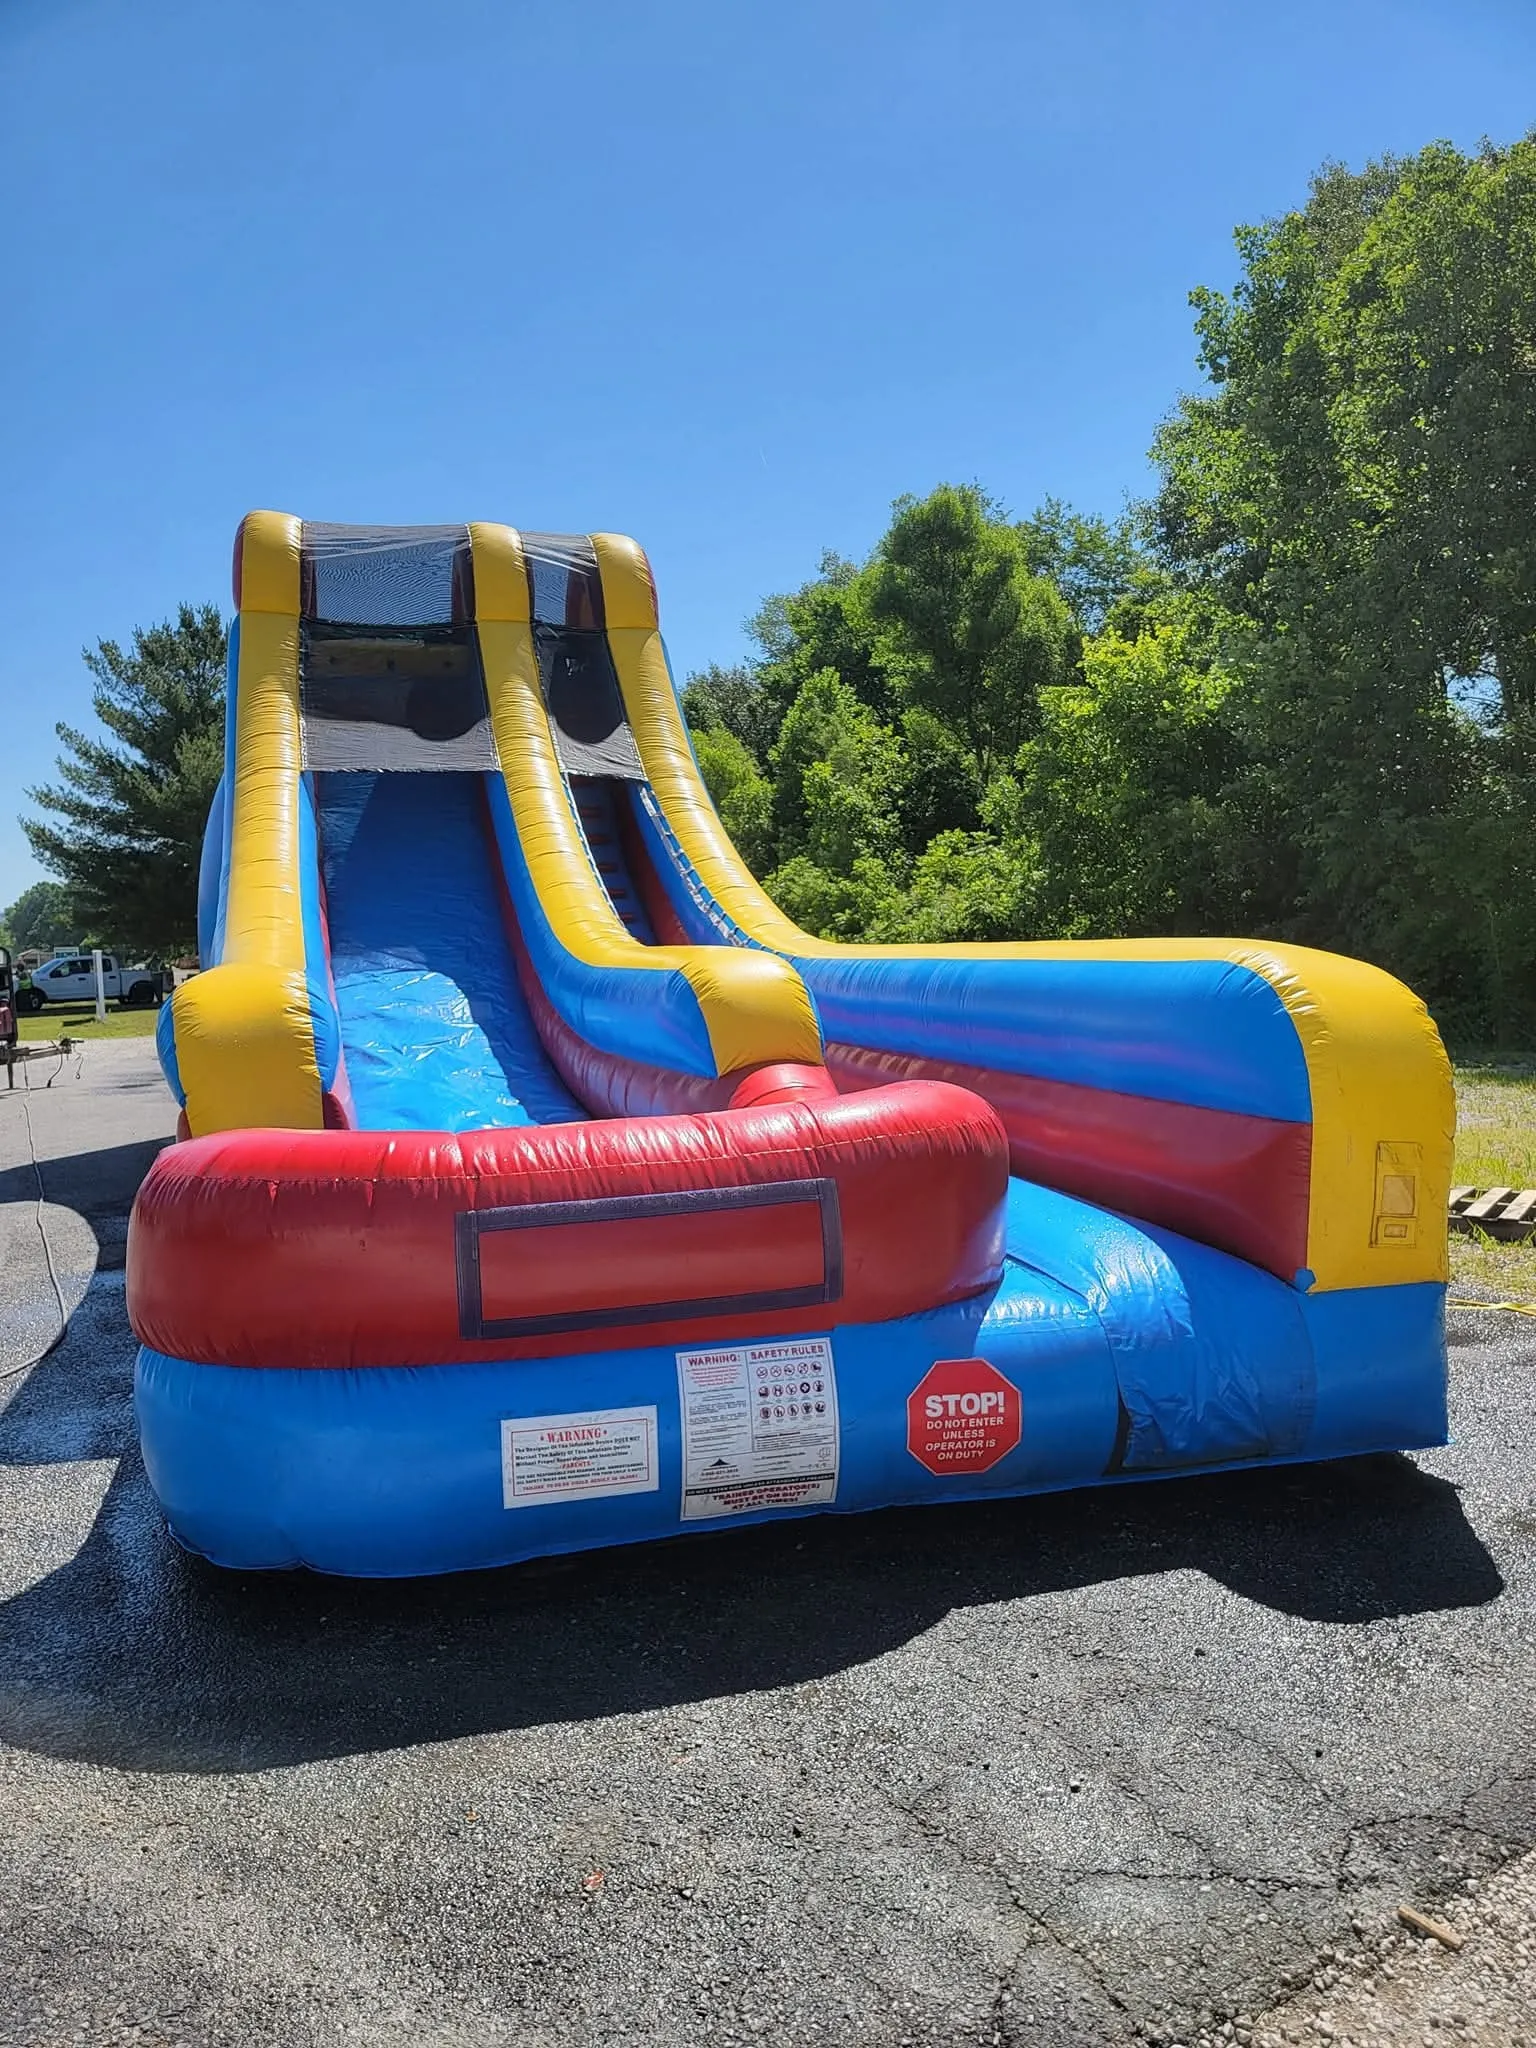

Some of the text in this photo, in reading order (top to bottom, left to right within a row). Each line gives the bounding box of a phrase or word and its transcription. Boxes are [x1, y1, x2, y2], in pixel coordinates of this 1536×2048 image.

[751, 1348, 789, 1360] SAFETY
[791, 1344, 824, 1355] RULES
[688, 1353, 740, 1366] WARNING:
[925, 1391, 1005, 1418] STOP!
[926, 1416, 1005, 1430] DO NOT ENTER
[547, 1427, 601, 1443] WARNING
[942, 1429, 985, 1440] UNLESS
[925, 1438, 996, 1452] OPERATOR IS
[937, 1449, 985, 1461] ON DUTY
[712, 1489, 755, 1501] TRAINED
[723, 1496, 750, 1506] MUST
[782, 1489, 809, 1498] DUTY
[745, 1500, 762, 1508] ALL
